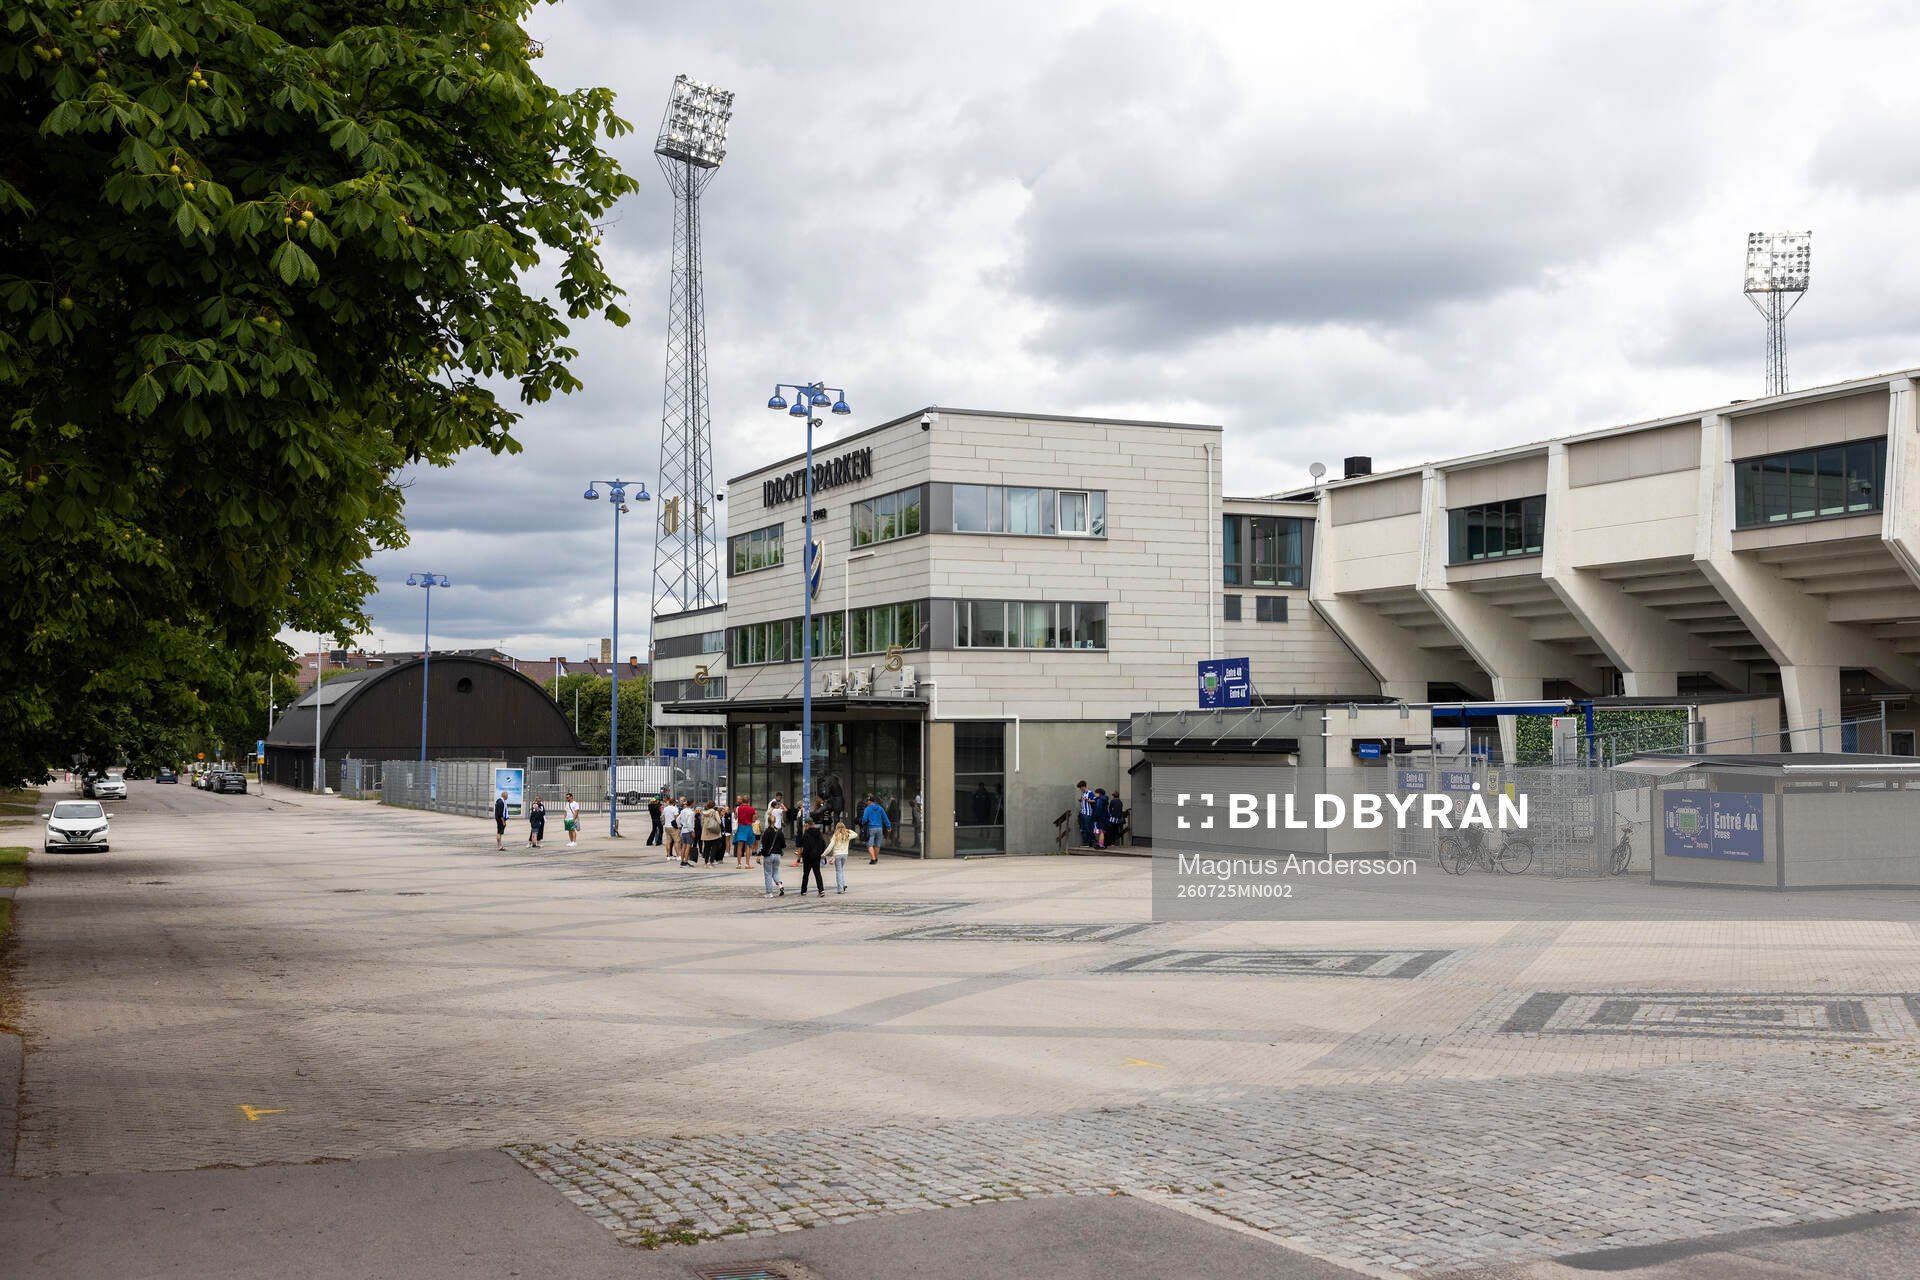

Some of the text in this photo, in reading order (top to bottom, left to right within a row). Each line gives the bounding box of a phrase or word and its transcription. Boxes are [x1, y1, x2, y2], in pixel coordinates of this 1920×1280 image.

[885, 645, 904, 672] 5
[1714, 812, 1741, 831] Entré
[1744, 813, 1758, 831] 4A
[1714, 829, 1731, 839] Press
